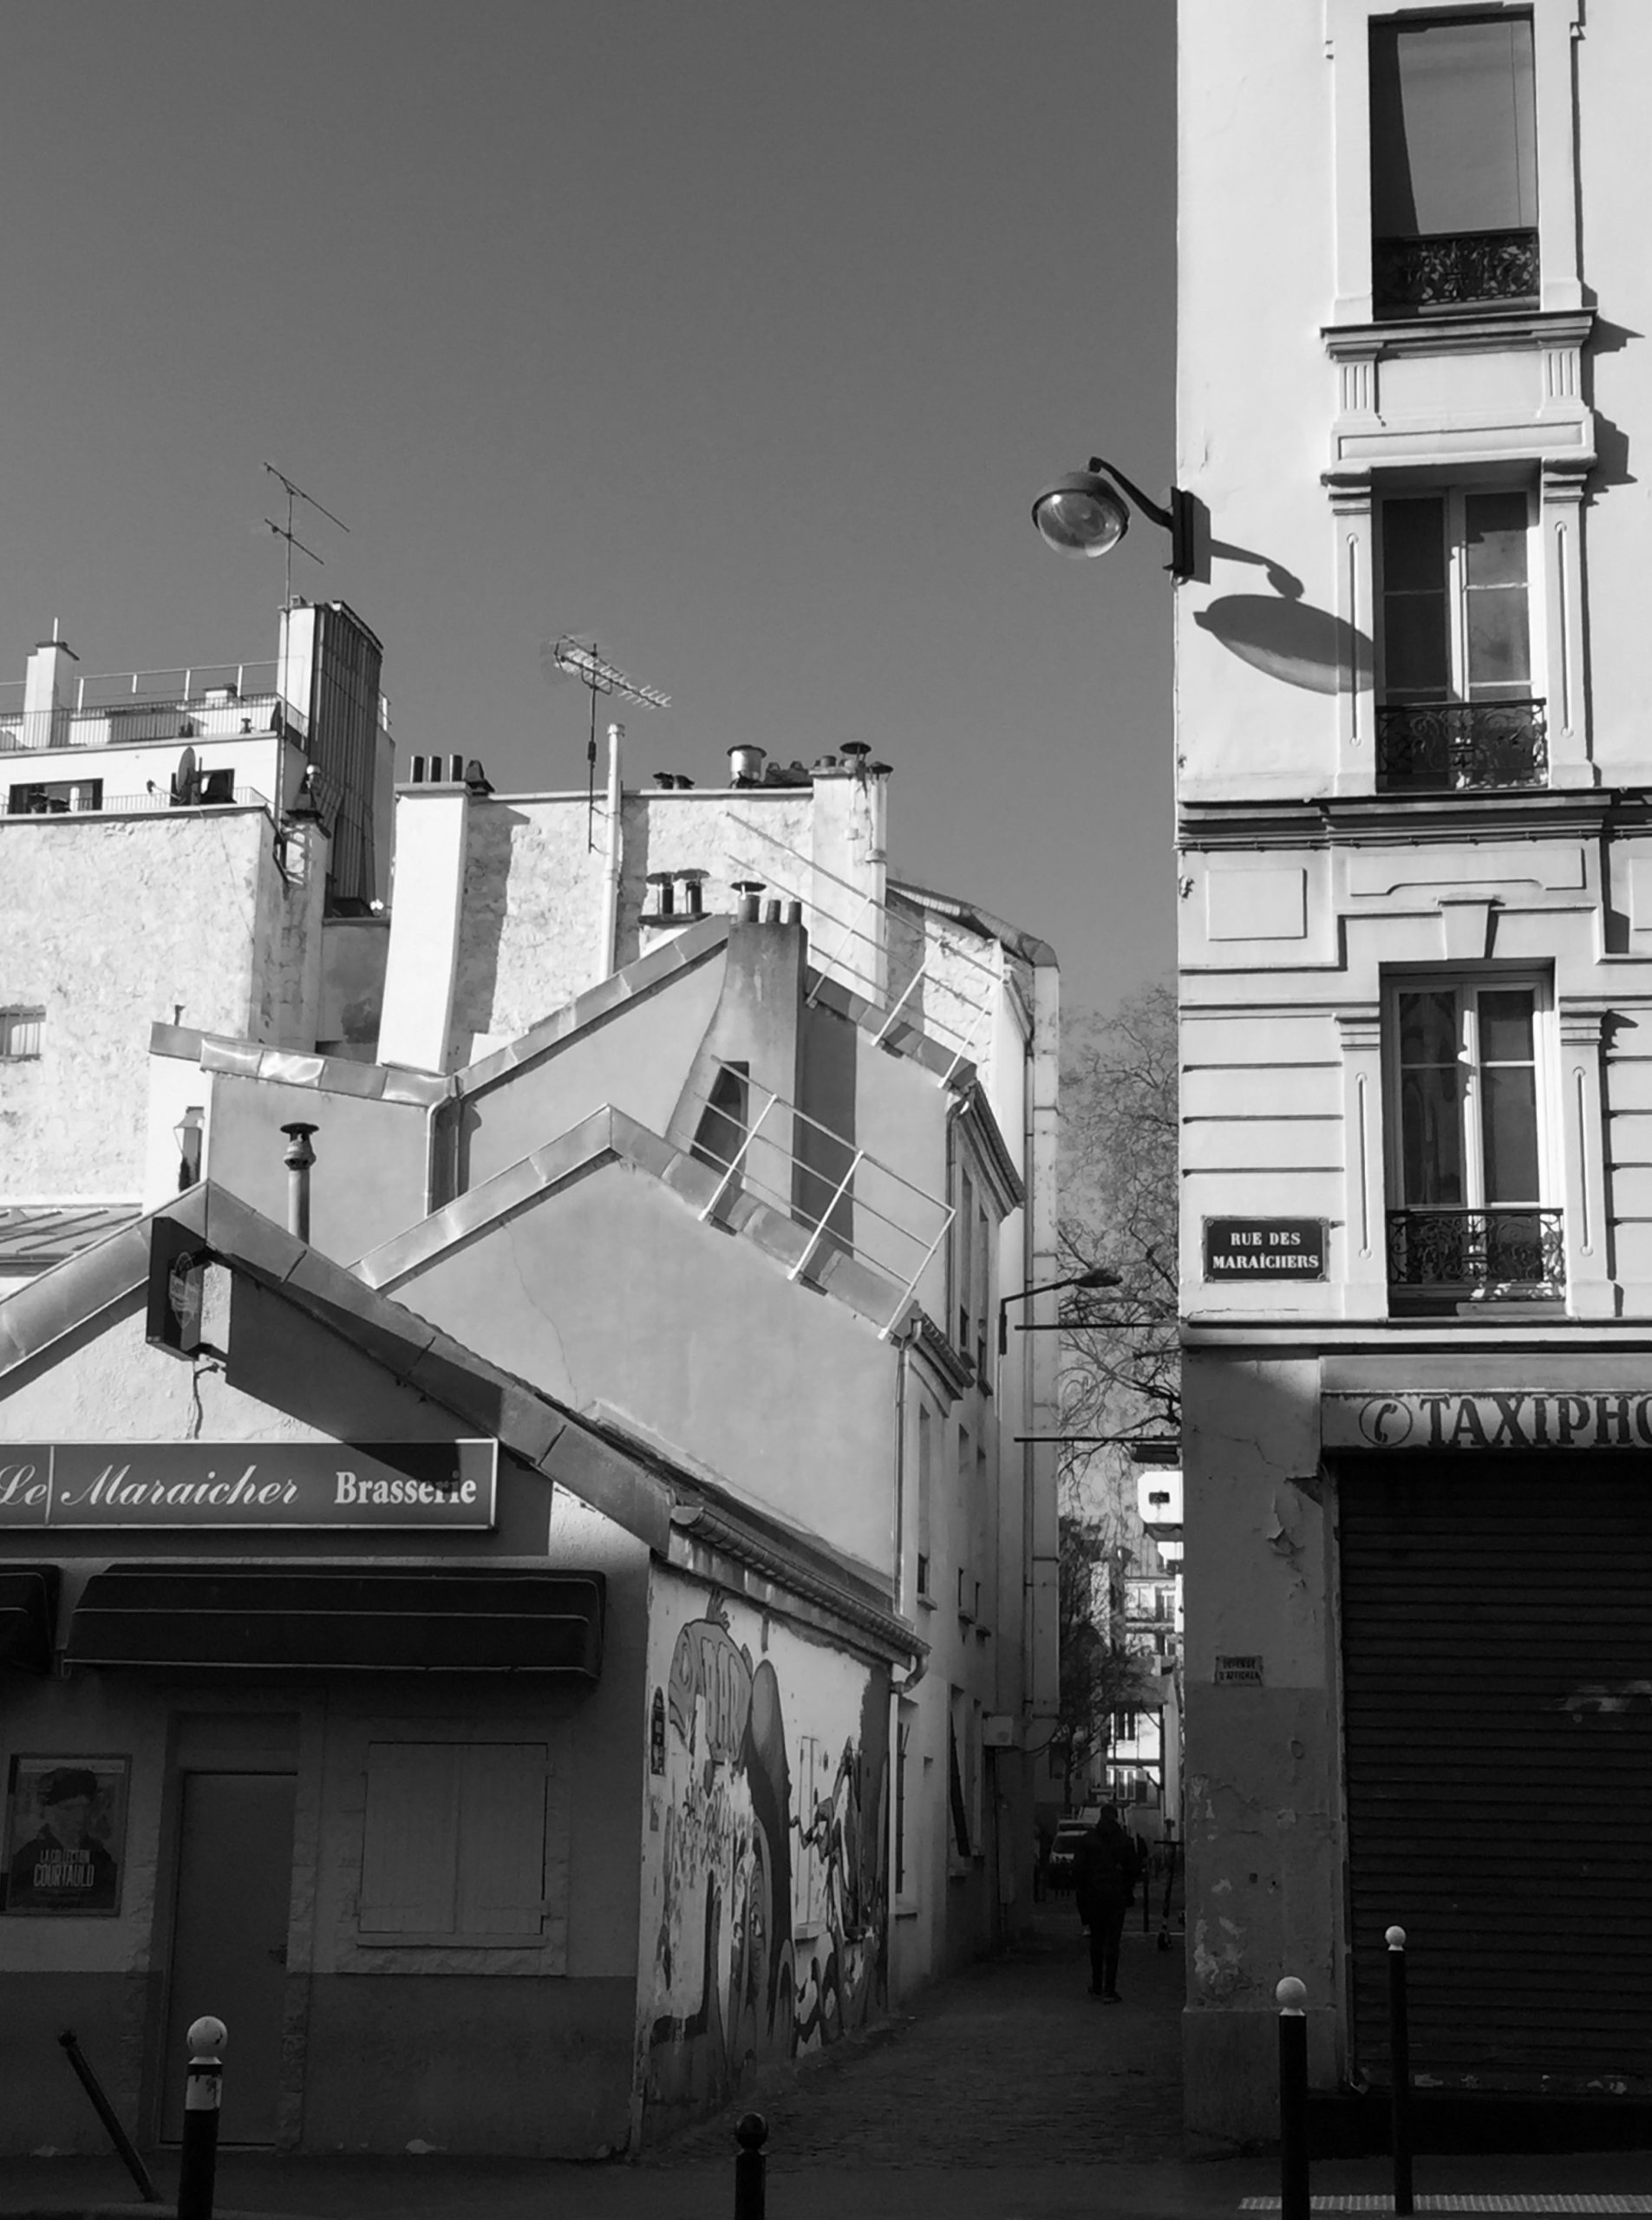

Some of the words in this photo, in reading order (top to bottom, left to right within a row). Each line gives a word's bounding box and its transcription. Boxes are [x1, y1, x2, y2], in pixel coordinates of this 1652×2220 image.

[1231, 1231, 1263, 1246] RUE
[1269, 1231, 1302, 1246] DES
[1212, 1251, 1319, 1269] MARAÎCHERS
[0, 1464, 47, 1505] Le
[61, 1464, 300, 1505] Maraicher
[334, 1470, 478, 1505] Brasserie
[34, 1863, 95, 1887] COURTAULD
